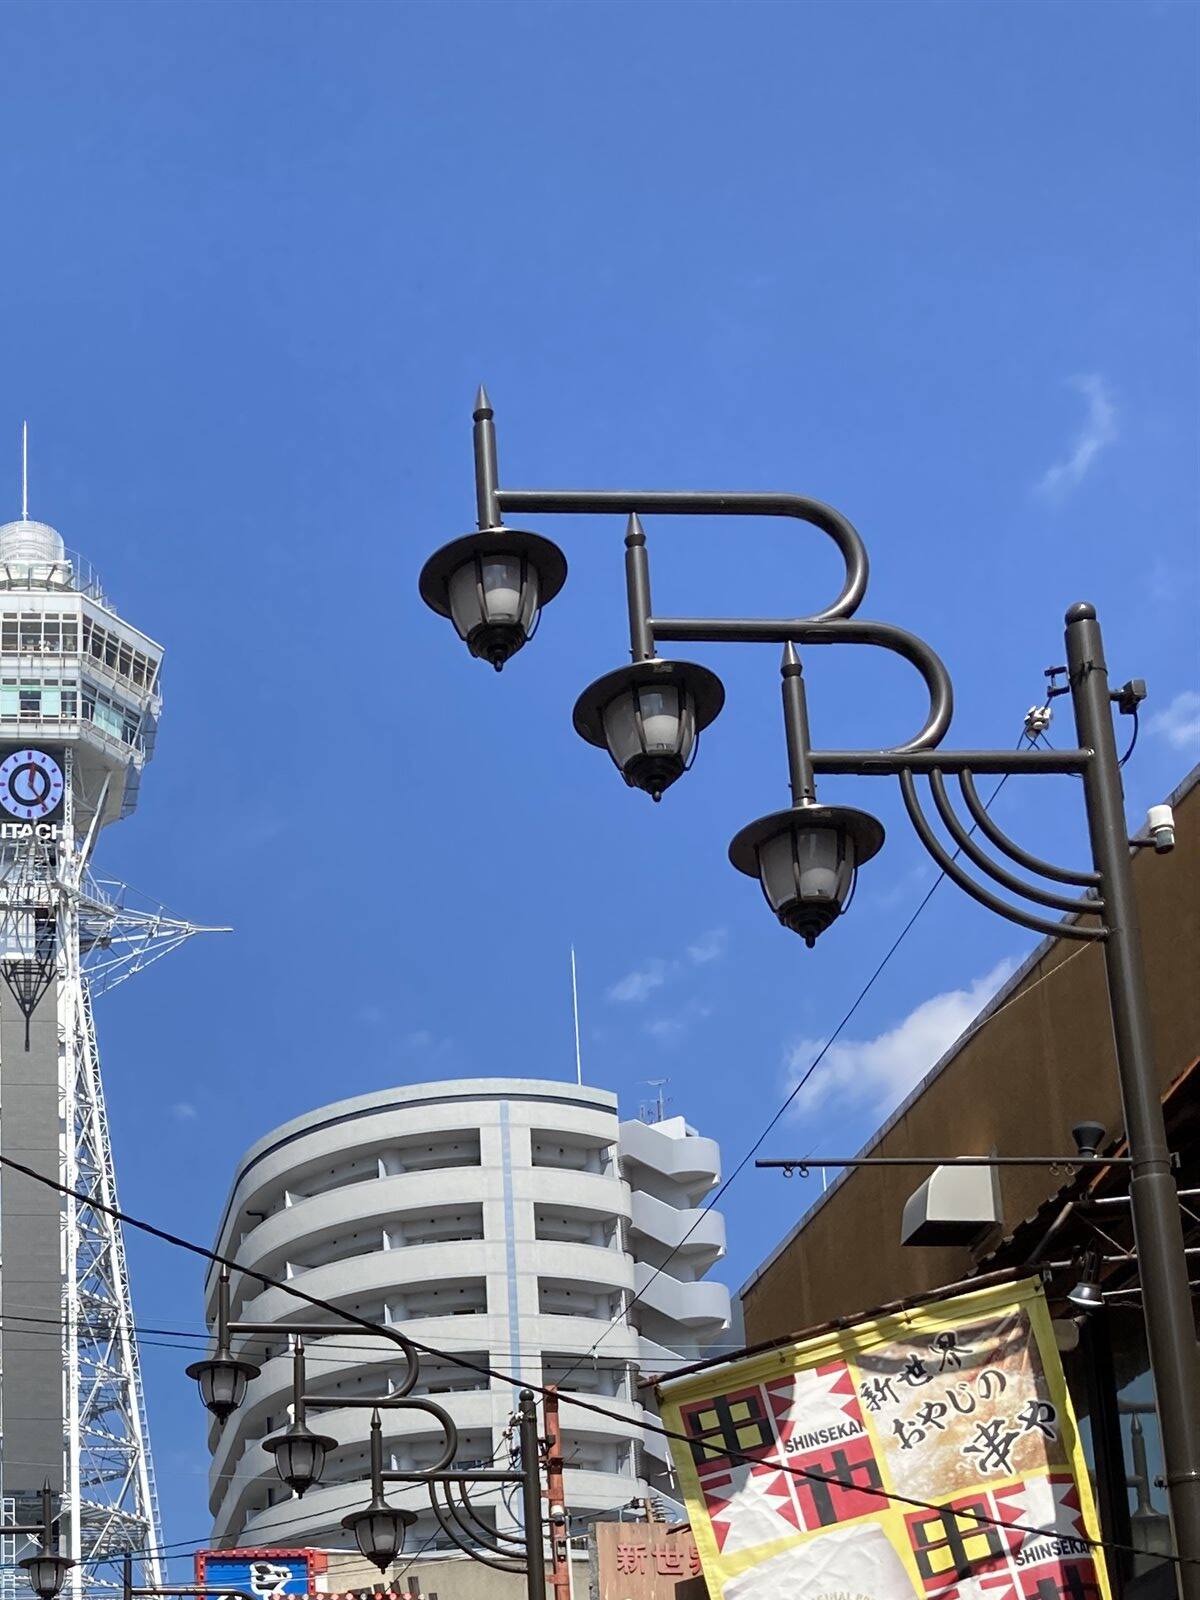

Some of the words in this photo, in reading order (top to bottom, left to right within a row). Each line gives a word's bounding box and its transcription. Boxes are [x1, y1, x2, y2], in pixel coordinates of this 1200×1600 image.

[860, 1330, 973, 1412] 新世界
[892, 1369, 1008, 1450] おやじの
[1016, 1538, 1091, 1566] SHINSEKA
